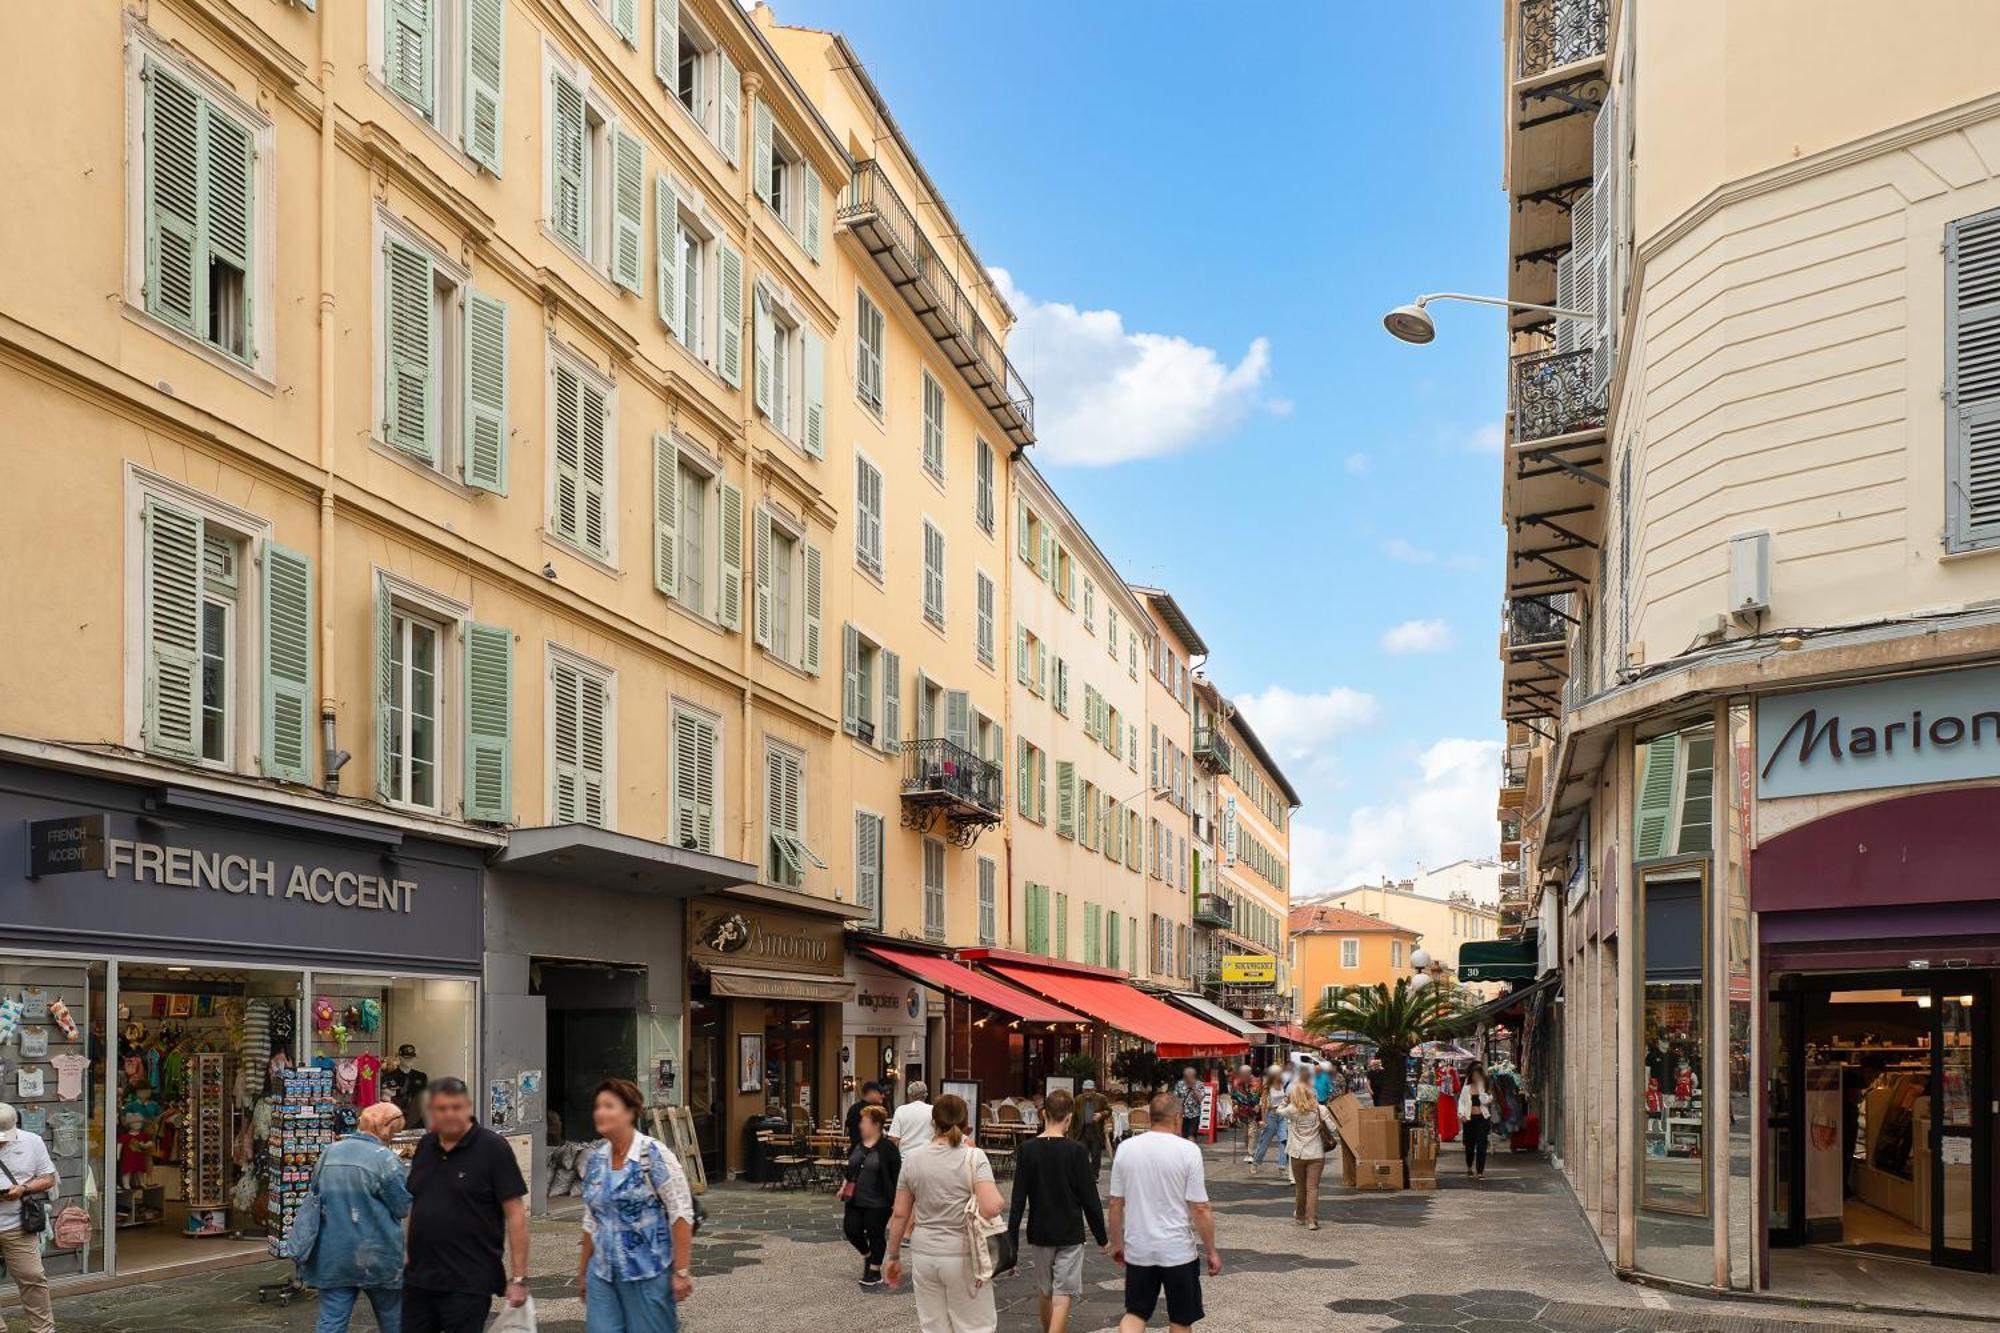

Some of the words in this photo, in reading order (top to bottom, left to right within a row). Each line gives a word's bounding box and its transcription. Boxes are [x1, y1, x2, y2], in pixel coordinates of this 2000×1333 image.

[48, 827, 87, 843] FRENCH
[1227, 796, 1235, 855] HOTEL
[48, 847, 87, 863] ACCENT
[108, 839, 275, 897] FRENCH
[285, 865, 418, 913] ACCENT
[749, 920, 827, 962] Amorino
[1467, 968, 1479, 977] 30
